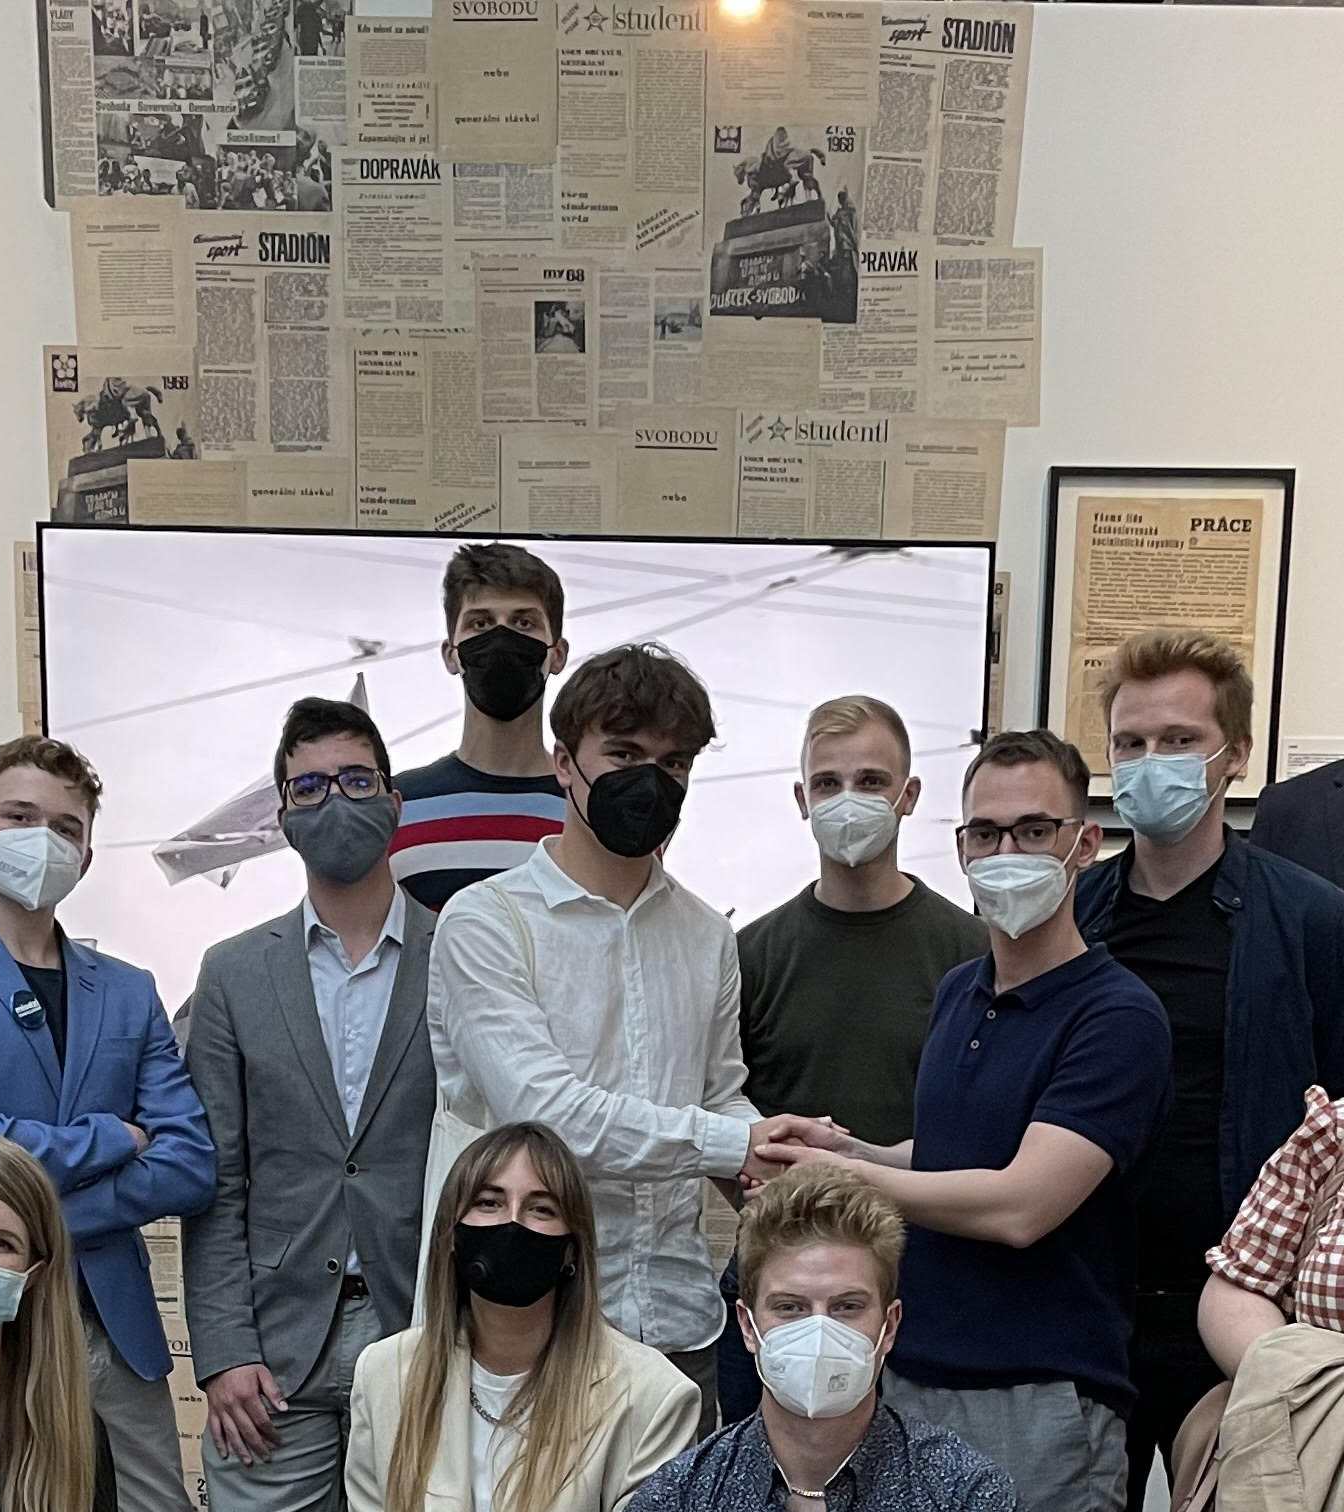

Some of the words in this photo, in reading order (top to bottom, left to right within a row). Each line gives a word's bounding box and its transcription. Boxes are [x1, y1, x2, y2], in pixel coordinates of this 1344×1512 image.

[453, 0, 538, 16] SVOBODU
[616, 5, 701, 31] student
[826, 137, 855, 153] 1968
[360, 154, 441, 181] DOPRAVÁK
[635, 429, 718, 445] SVOBODU
[798, 419, 883, 444] student
[1190, 515, 1253, 533] PRÁCE
